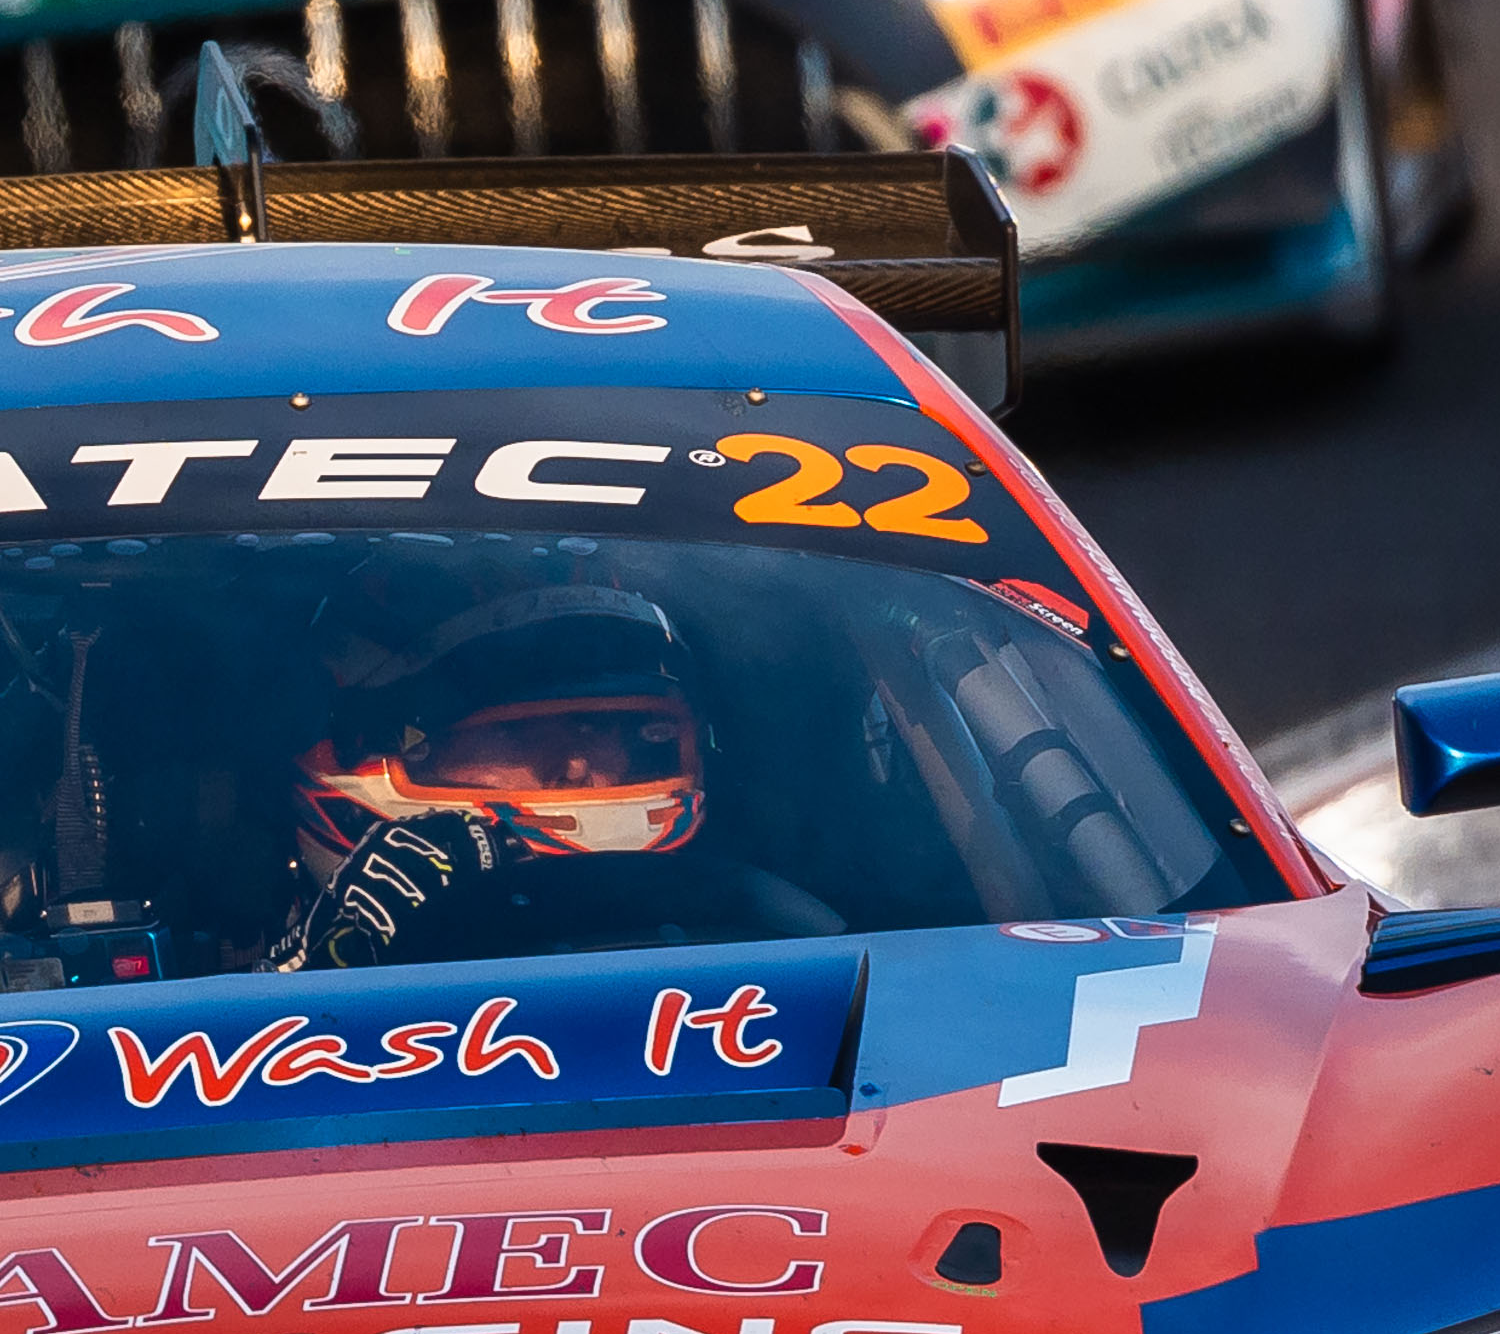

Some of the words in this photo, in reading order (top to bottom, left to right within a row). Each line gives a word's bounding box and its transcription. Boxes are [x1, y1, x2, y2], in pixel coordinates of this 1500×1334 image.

[386, 273, 668, 339] It
[713, 432, 990, 546] 22
[108, 997, 560, 1108] Wash
[644, 984, 784, 1076] It
